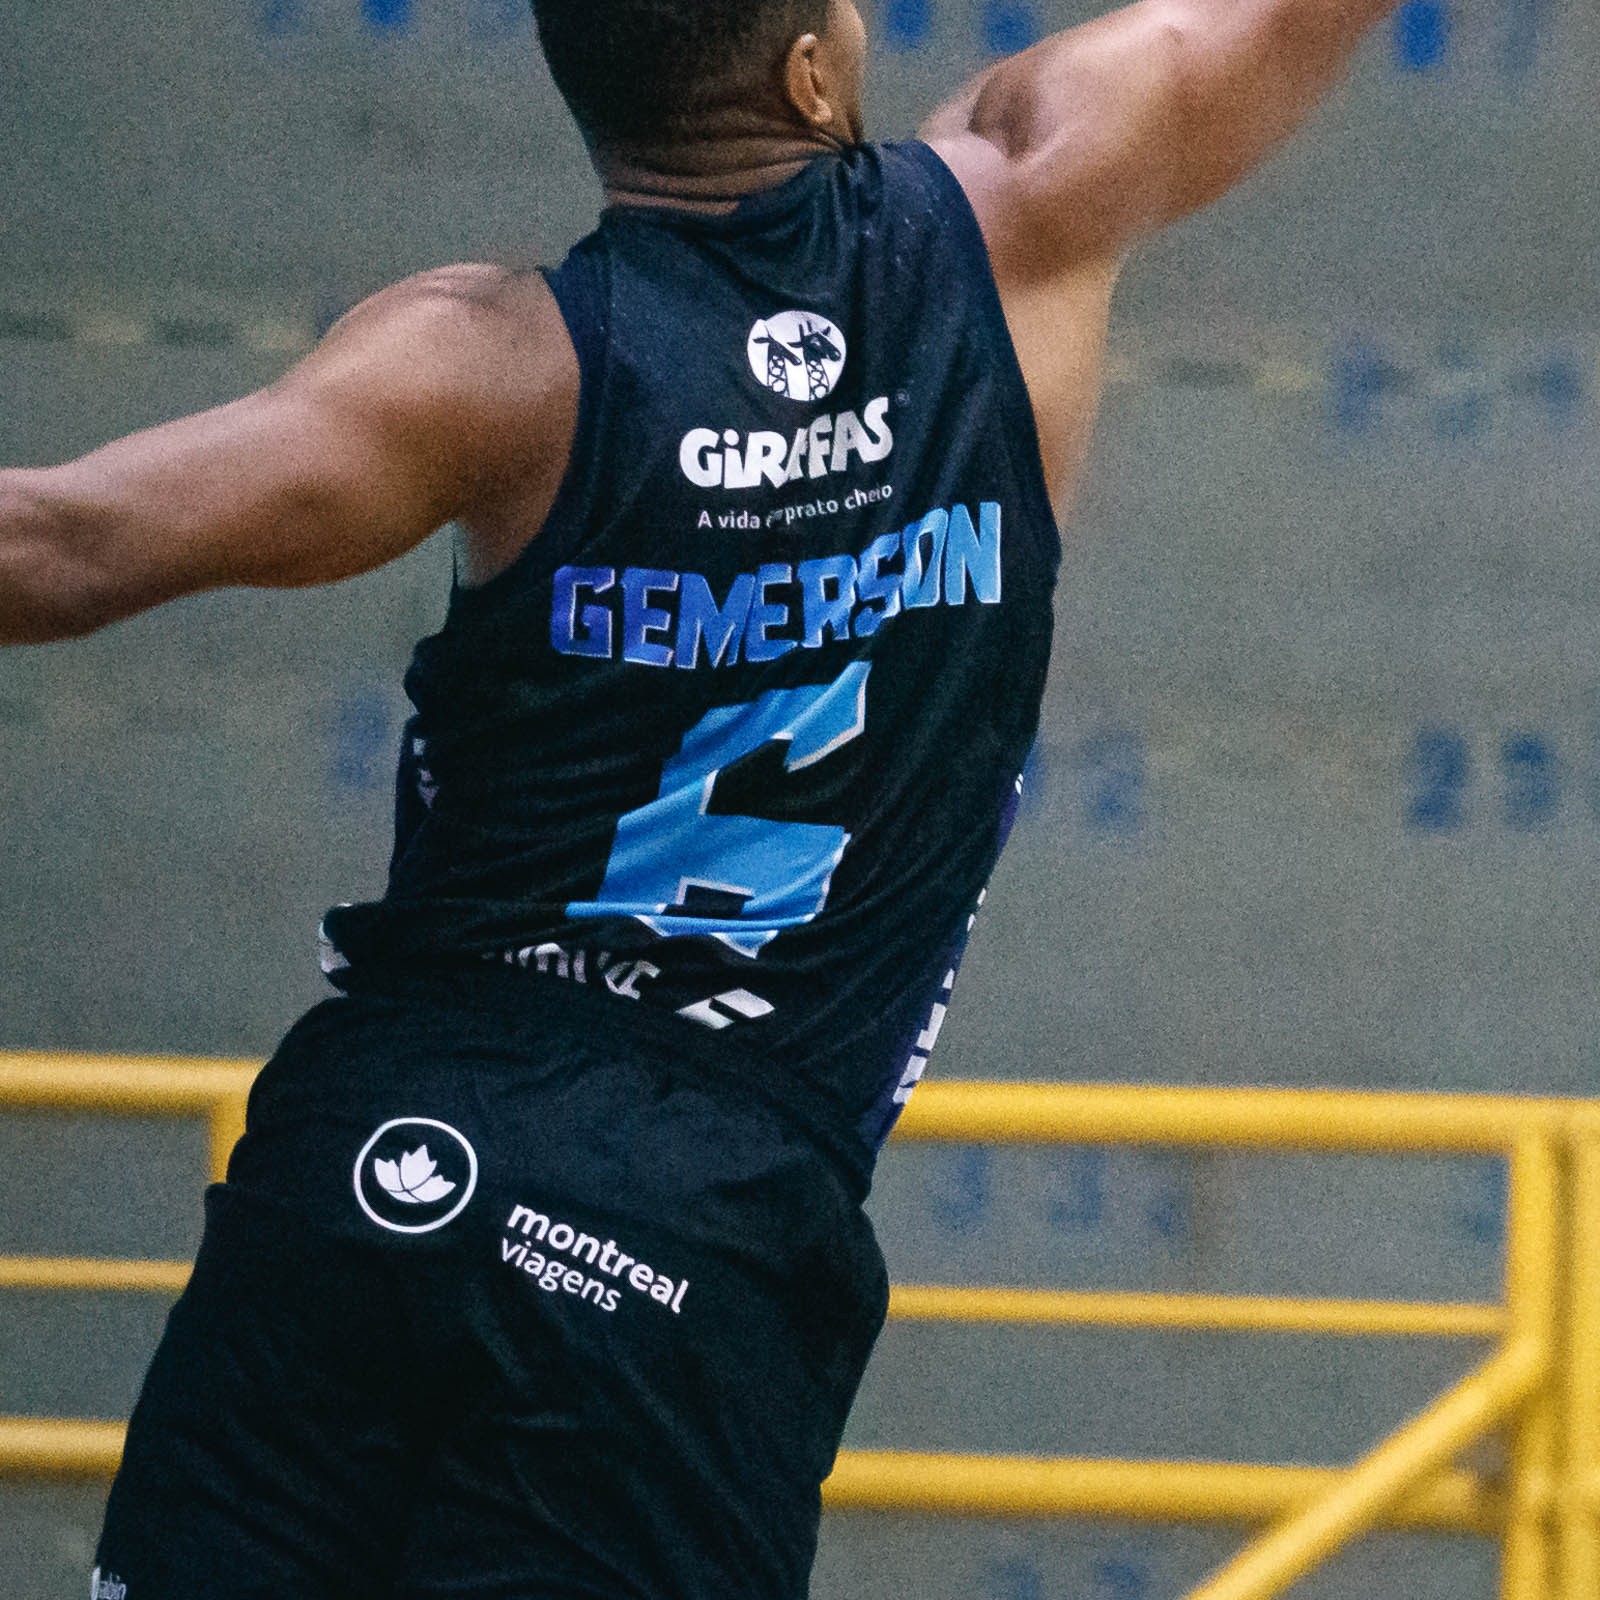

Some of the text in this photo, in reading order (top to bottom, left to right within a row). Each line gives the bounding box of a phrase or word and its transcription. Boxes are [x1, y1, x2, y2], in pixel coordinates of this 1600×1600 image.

[698, 510, 712, 528] A
[718, 509, 760, 529] vida
[783, 499, 839, 525] prato
[550, 501, 1001, 670] GEMERSON
[501, 1227, 623, 1312] viagens
[506, 1203, 690, 1314] montreal
